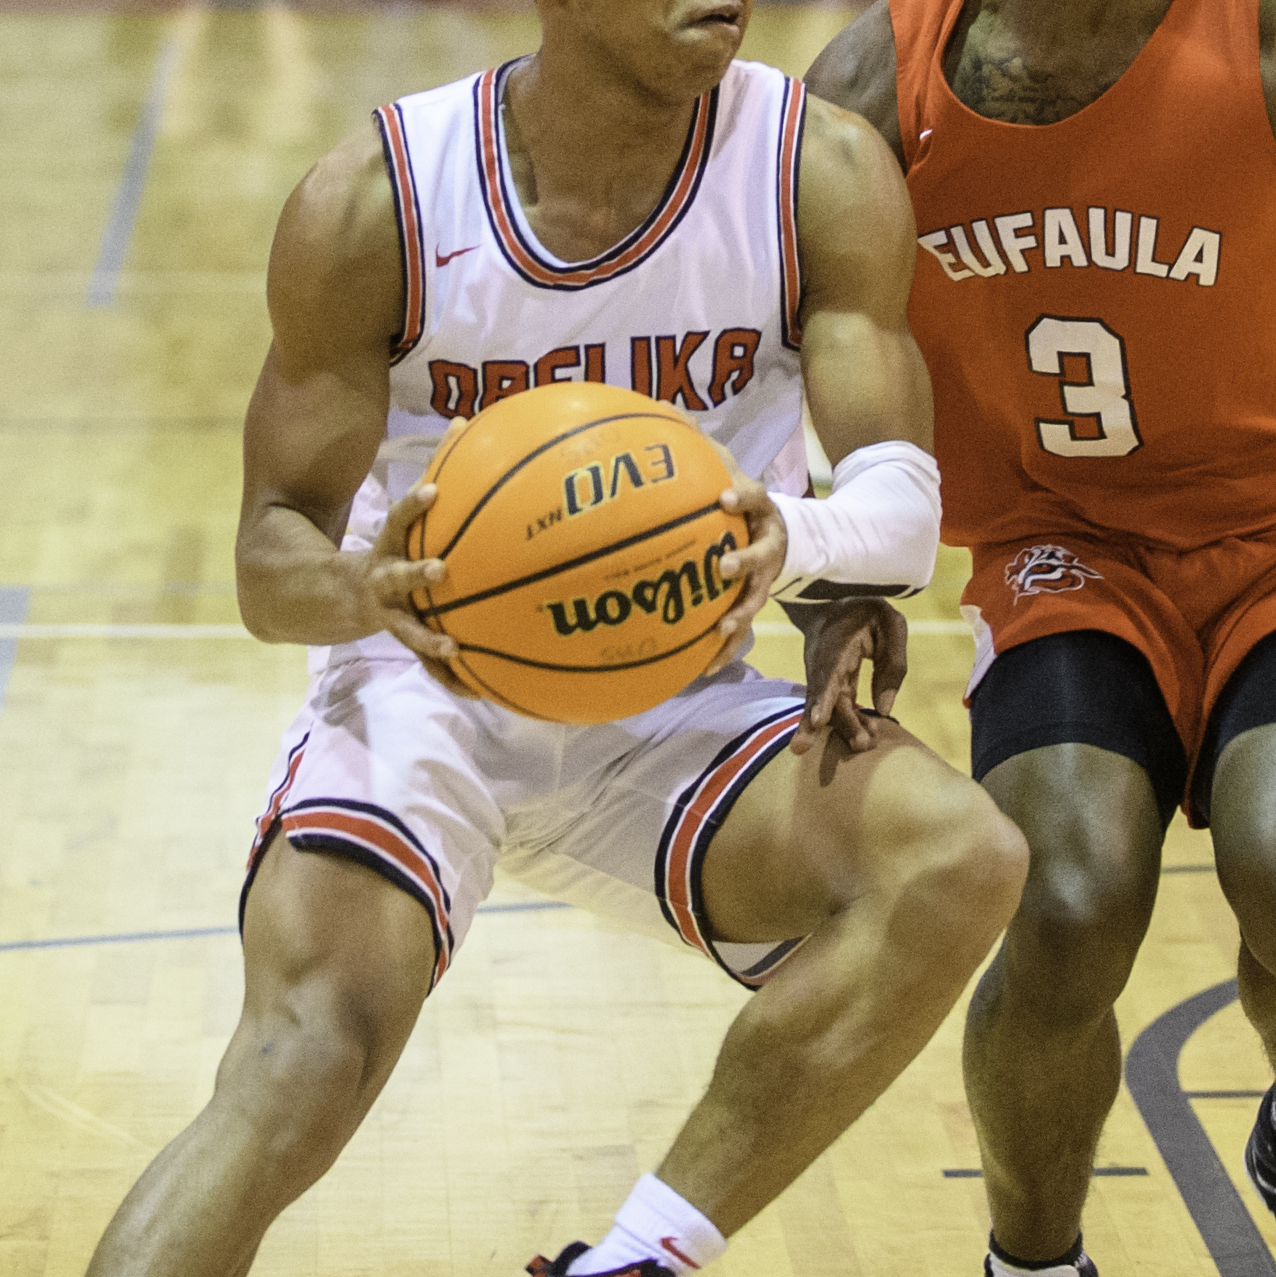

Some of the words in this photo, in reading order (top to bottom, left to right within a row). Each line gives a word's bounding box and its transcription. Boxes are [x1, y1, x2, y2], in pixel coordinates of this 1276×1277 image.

[917, 205, 1221, 287] EUFAULA
[1025, 313, 1144, 458] 3
[564, 443, 676, 516] EVO
[544, 531, 737, 636] Wilson
